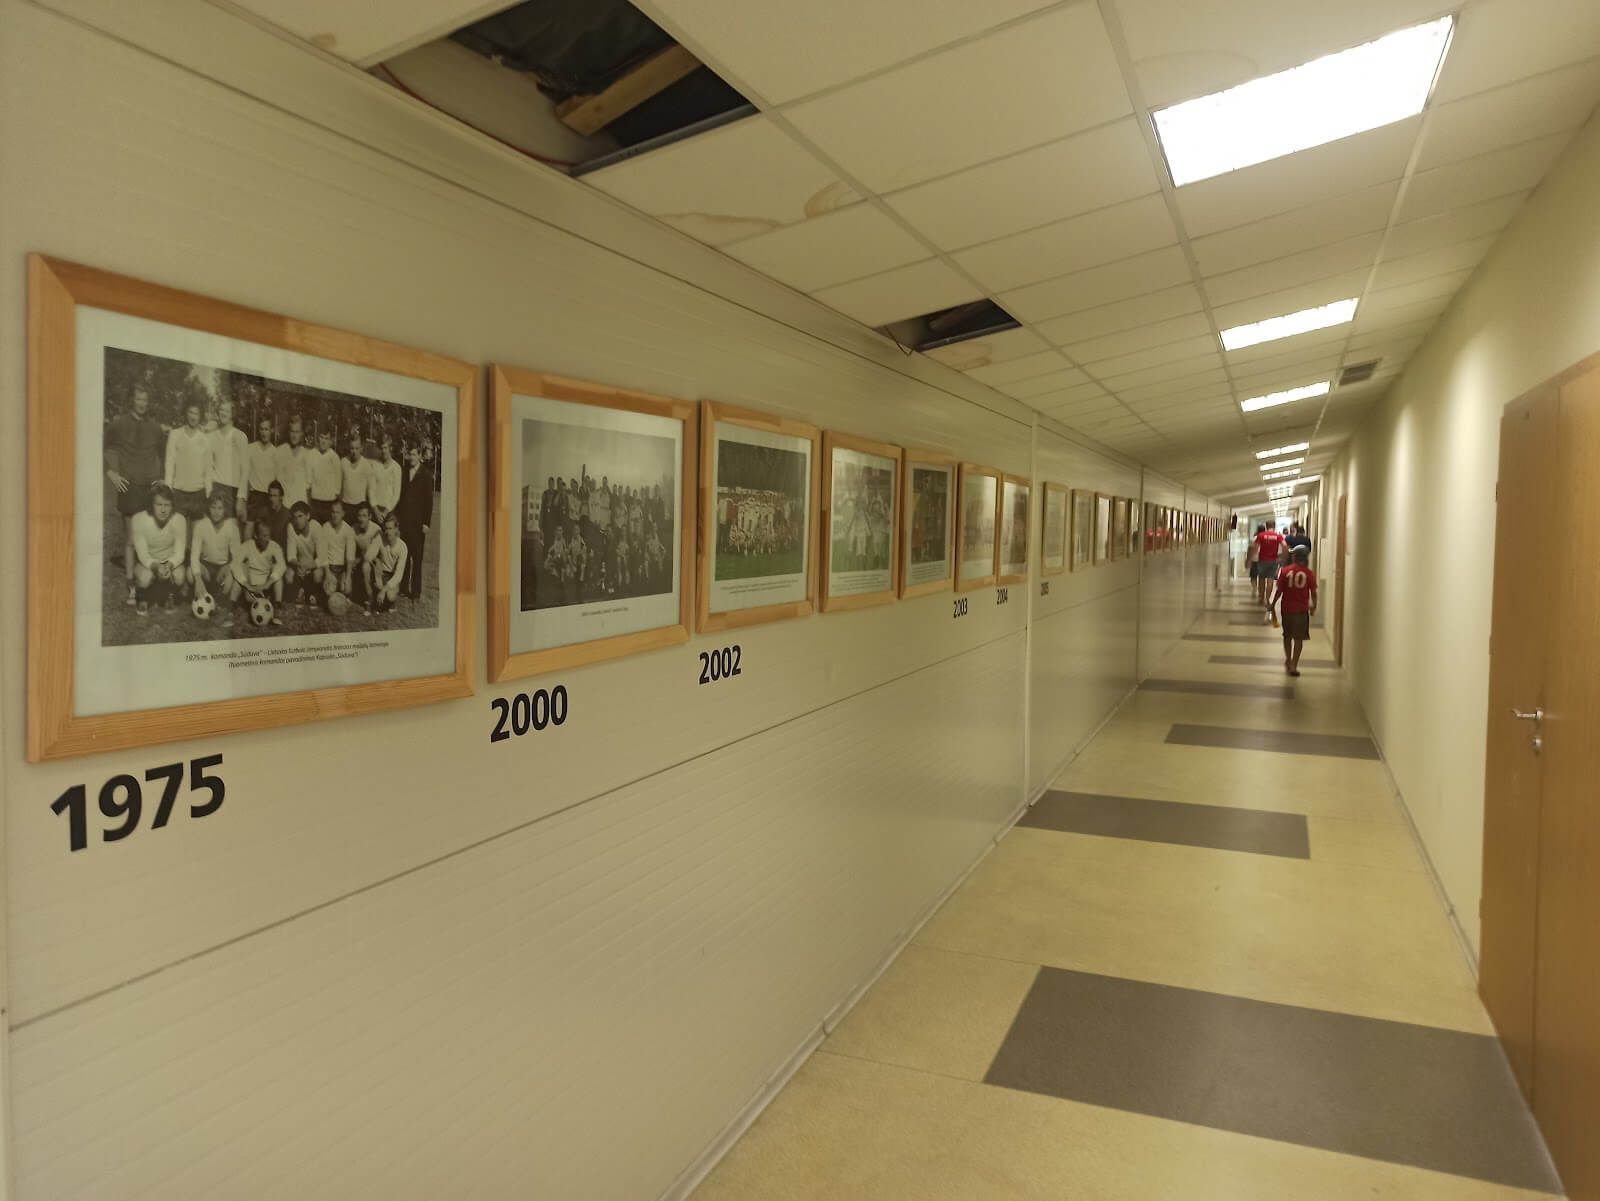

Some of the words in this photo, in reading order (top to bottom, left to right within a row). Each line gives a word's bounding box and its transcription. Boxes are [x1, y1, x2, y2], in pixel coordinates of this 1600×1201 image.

[1286, 570, 1307, 589] 10
[953, 598, 968, 619] 2003
[996, 588, 1008, 605] 2004
[699, 645, 742, 685] 2002
[490, 685, 568, 743] 2000
[50, 753, 225, 852] 1975
